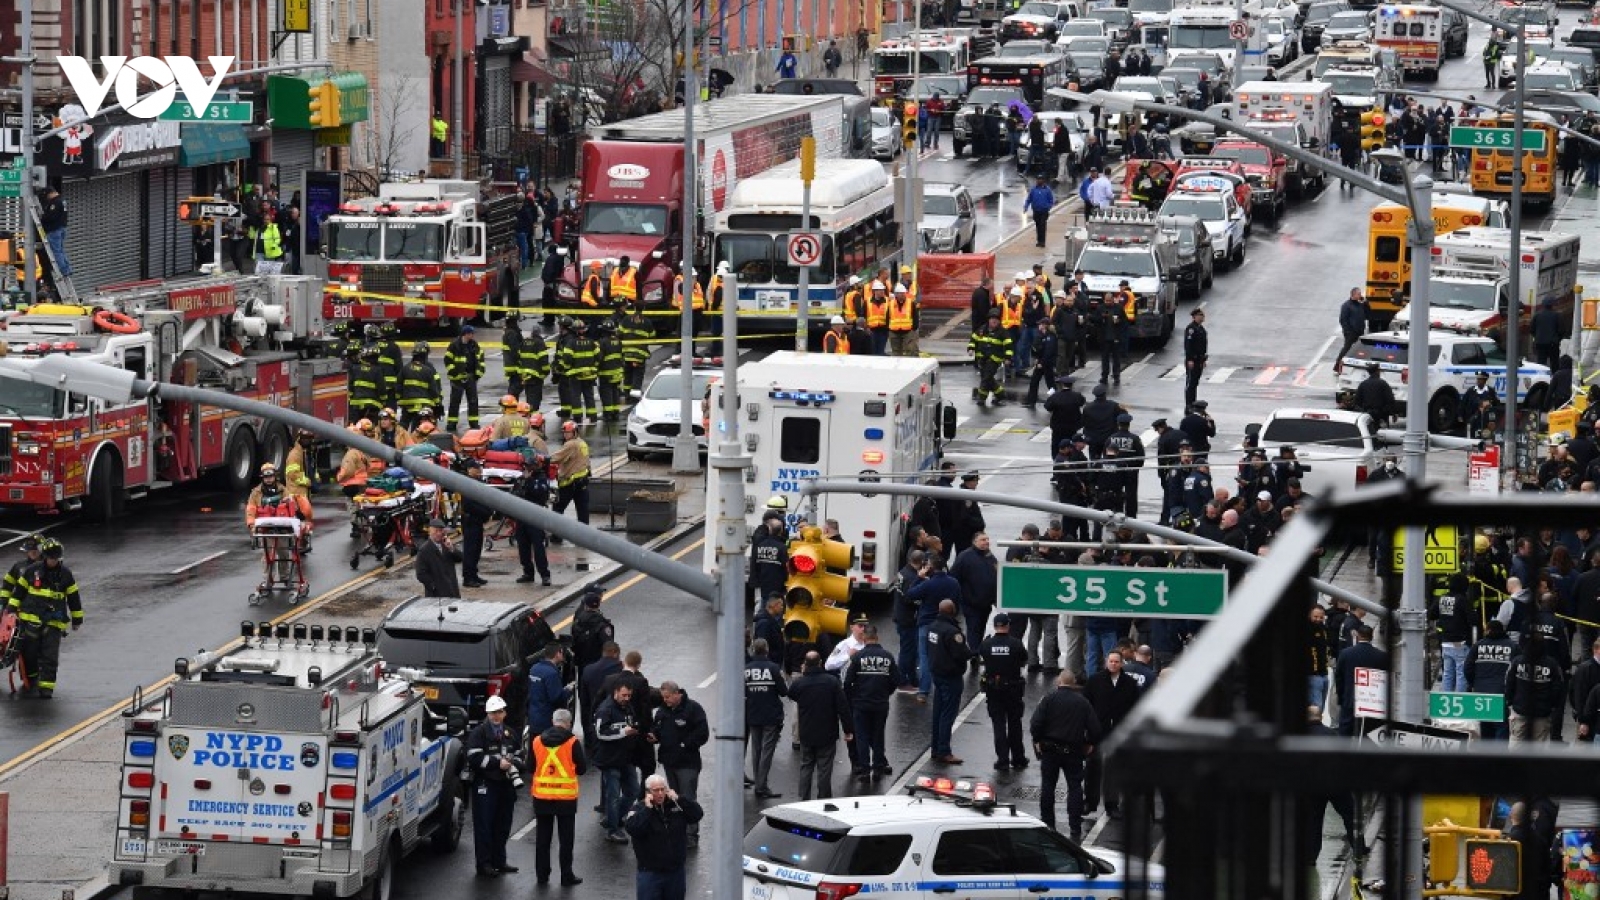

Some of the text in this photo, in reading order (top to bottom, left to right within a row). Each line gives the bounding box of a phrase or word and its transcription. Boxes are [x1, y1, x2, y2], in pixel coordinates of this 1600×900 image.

[210, 105, 229, 118] St
[1474, 132, 1511, 145] 36 S
[334, 305, 354, 318] 201
[1397, 553, 1454, 565] SOOL
[1056, 576, 1169, 607] 35 St
[1477, 645, 1512, 655] NYPD
[860, 656, 892, 667] NYPD
[745, 668, 773, 681] PBA
[1517, 663, 1551, 676] NPD
[1438, 695, 1493, 717] 35 ST
[206, 732, 283, 752] NYPD
[193, 750, 295, 771] POLICE
[188, 799, 295, 817] EMERGENCY SERVICE
[214, 820, 246, 828] BACK
[775, 868, 812, 883] POLICE
